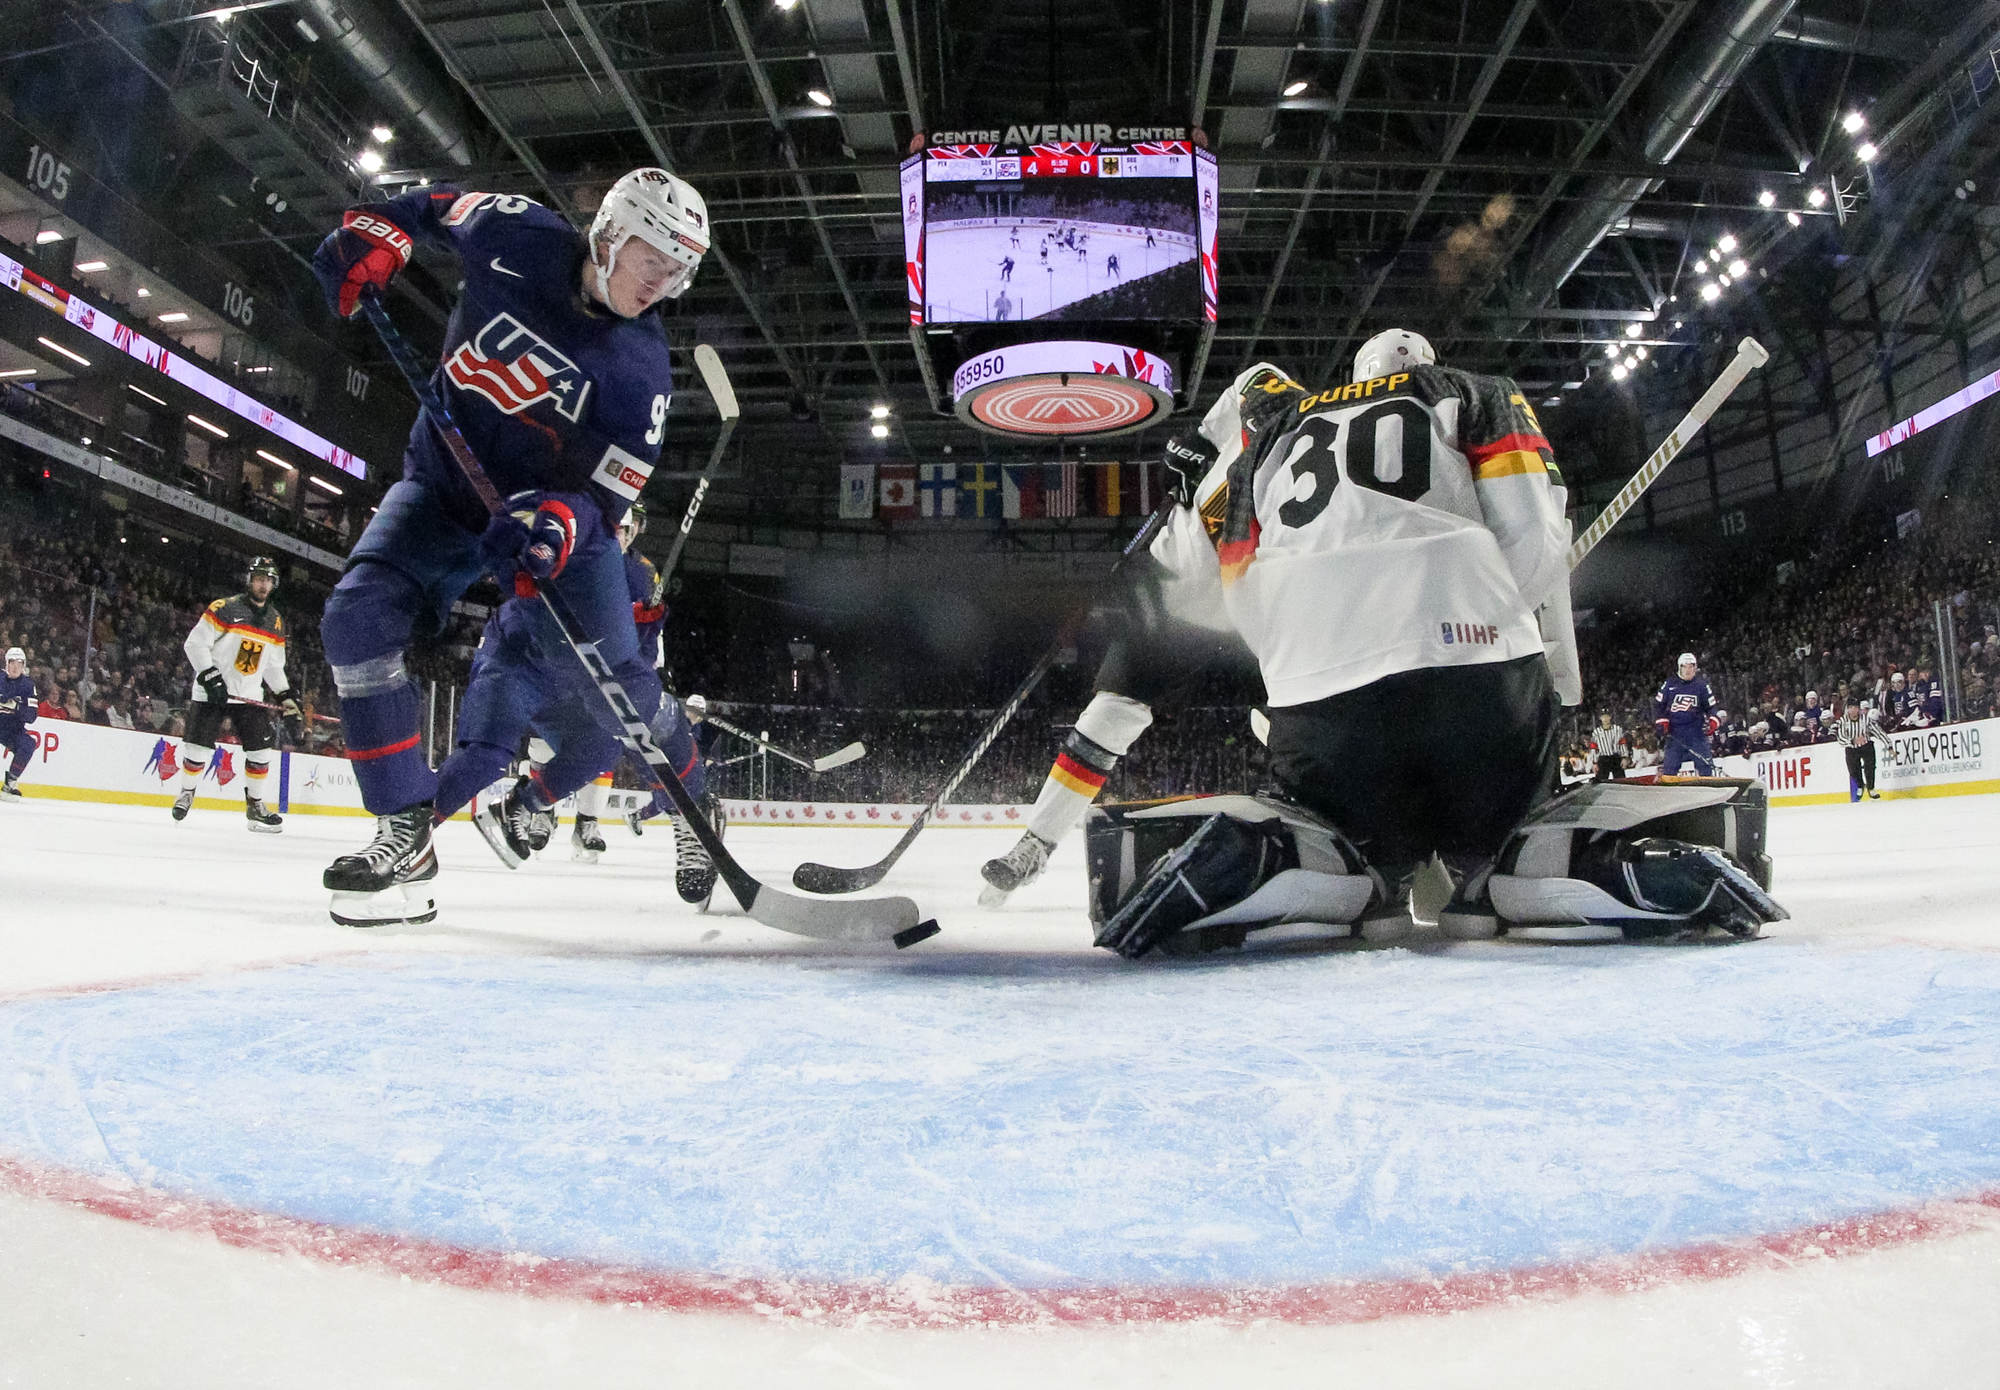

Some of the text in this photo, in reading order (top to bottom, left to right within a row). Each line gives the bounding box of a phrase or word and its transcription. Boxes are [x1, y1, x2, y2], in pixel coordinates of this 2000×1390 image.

[931, 124, 1186, 145] CENTRE AVENIR CENTRE
[27, 145, 71, 200] 105
[982, 168, 993, 176] 21
[1027, 162, 1039, 175] 4
[1080, 161, 1090, 174] 0
[223, 281, 254, 326] 106
[346, 365, 370, 401] 107
[445, 311, 591, 423] USA
[645, 394, 672, 444] 9
[1279, 399, 1431, 529] 30
[681, 477, 709, 534] CCM
[1720, 510, 1747, 536] 113
[274, 616, 282, 631] A
[1456, 623, 1499, 645] IIHF
[575, 643, 670, 765] CCM
[328, 773, 358, 786] MON
[1768, 757, 1811, 791] IIHF
